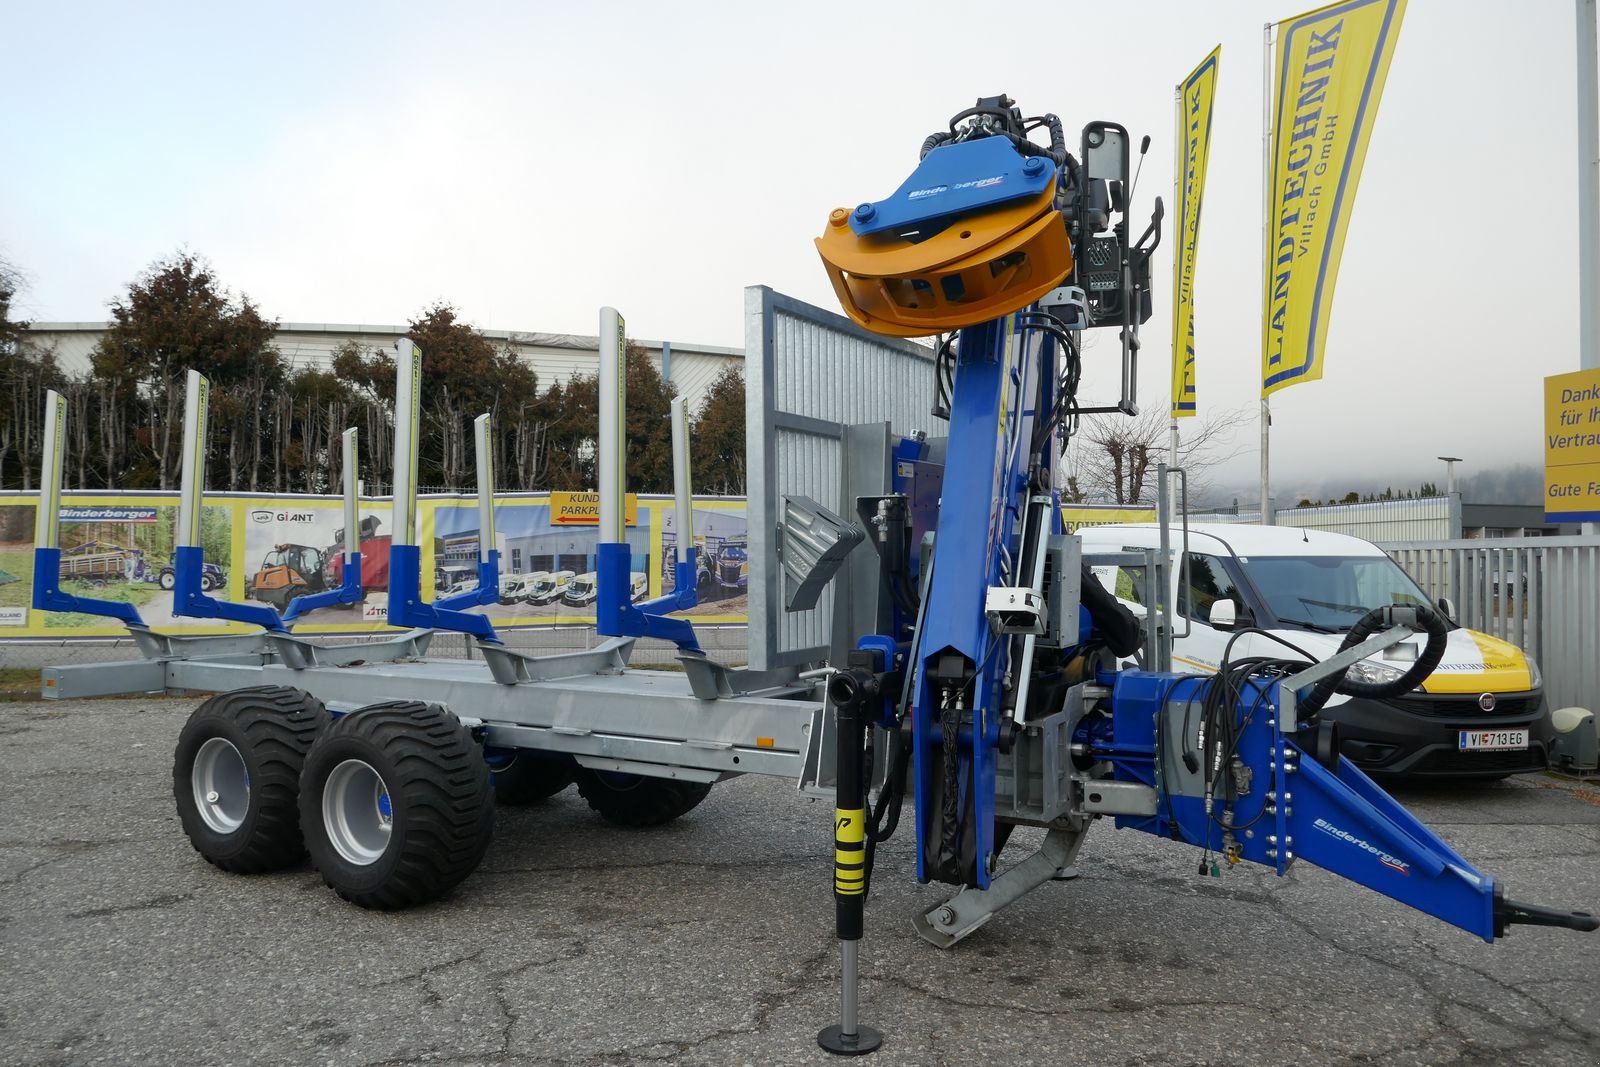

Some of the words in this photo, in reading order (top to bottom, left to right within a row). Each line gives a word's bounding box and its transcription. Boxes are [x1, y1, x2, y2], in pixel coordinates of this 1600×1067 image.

[1269, 18, 1344, 370] LANDTECHNIK
[1298, 185, 1323, 258] Villach
[1313, 114, 1339, 176] GmbH
[1561, 383, 1600, 404] Dank
[1560, 409, 1583, 426] für
[569, 494, 600, 503] KUND
[1549, 483, 1581, 497] Gute
[59, 508, 156, 519] Binderberger
[561, 505, 600, 515] PARKPL
[1313, 817, 1411, 869] Binderberger
